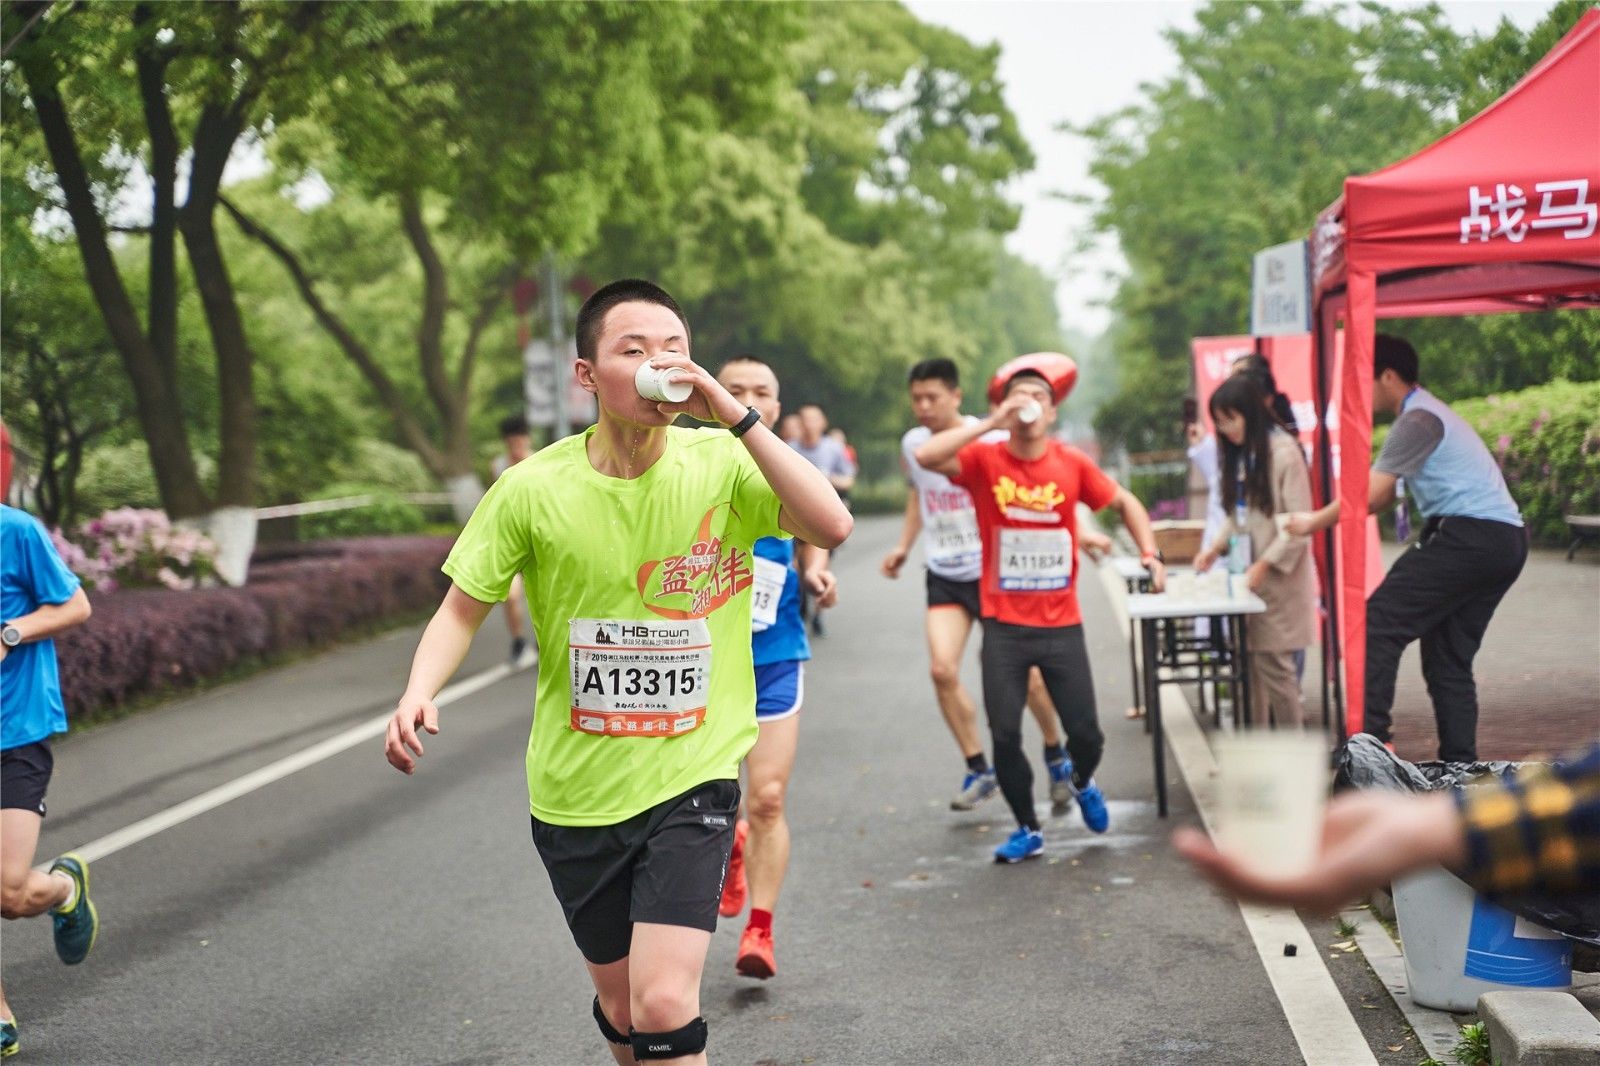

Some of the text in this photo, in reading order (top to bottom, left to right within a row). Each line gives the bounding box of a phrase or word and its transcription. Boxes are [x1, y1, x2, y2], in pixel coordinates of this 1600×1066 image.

[1459, 179, 1599, 244] 战马
[582, 666, 695, 696] A13315
[648, 1044, 672, 1052] CAMEL
